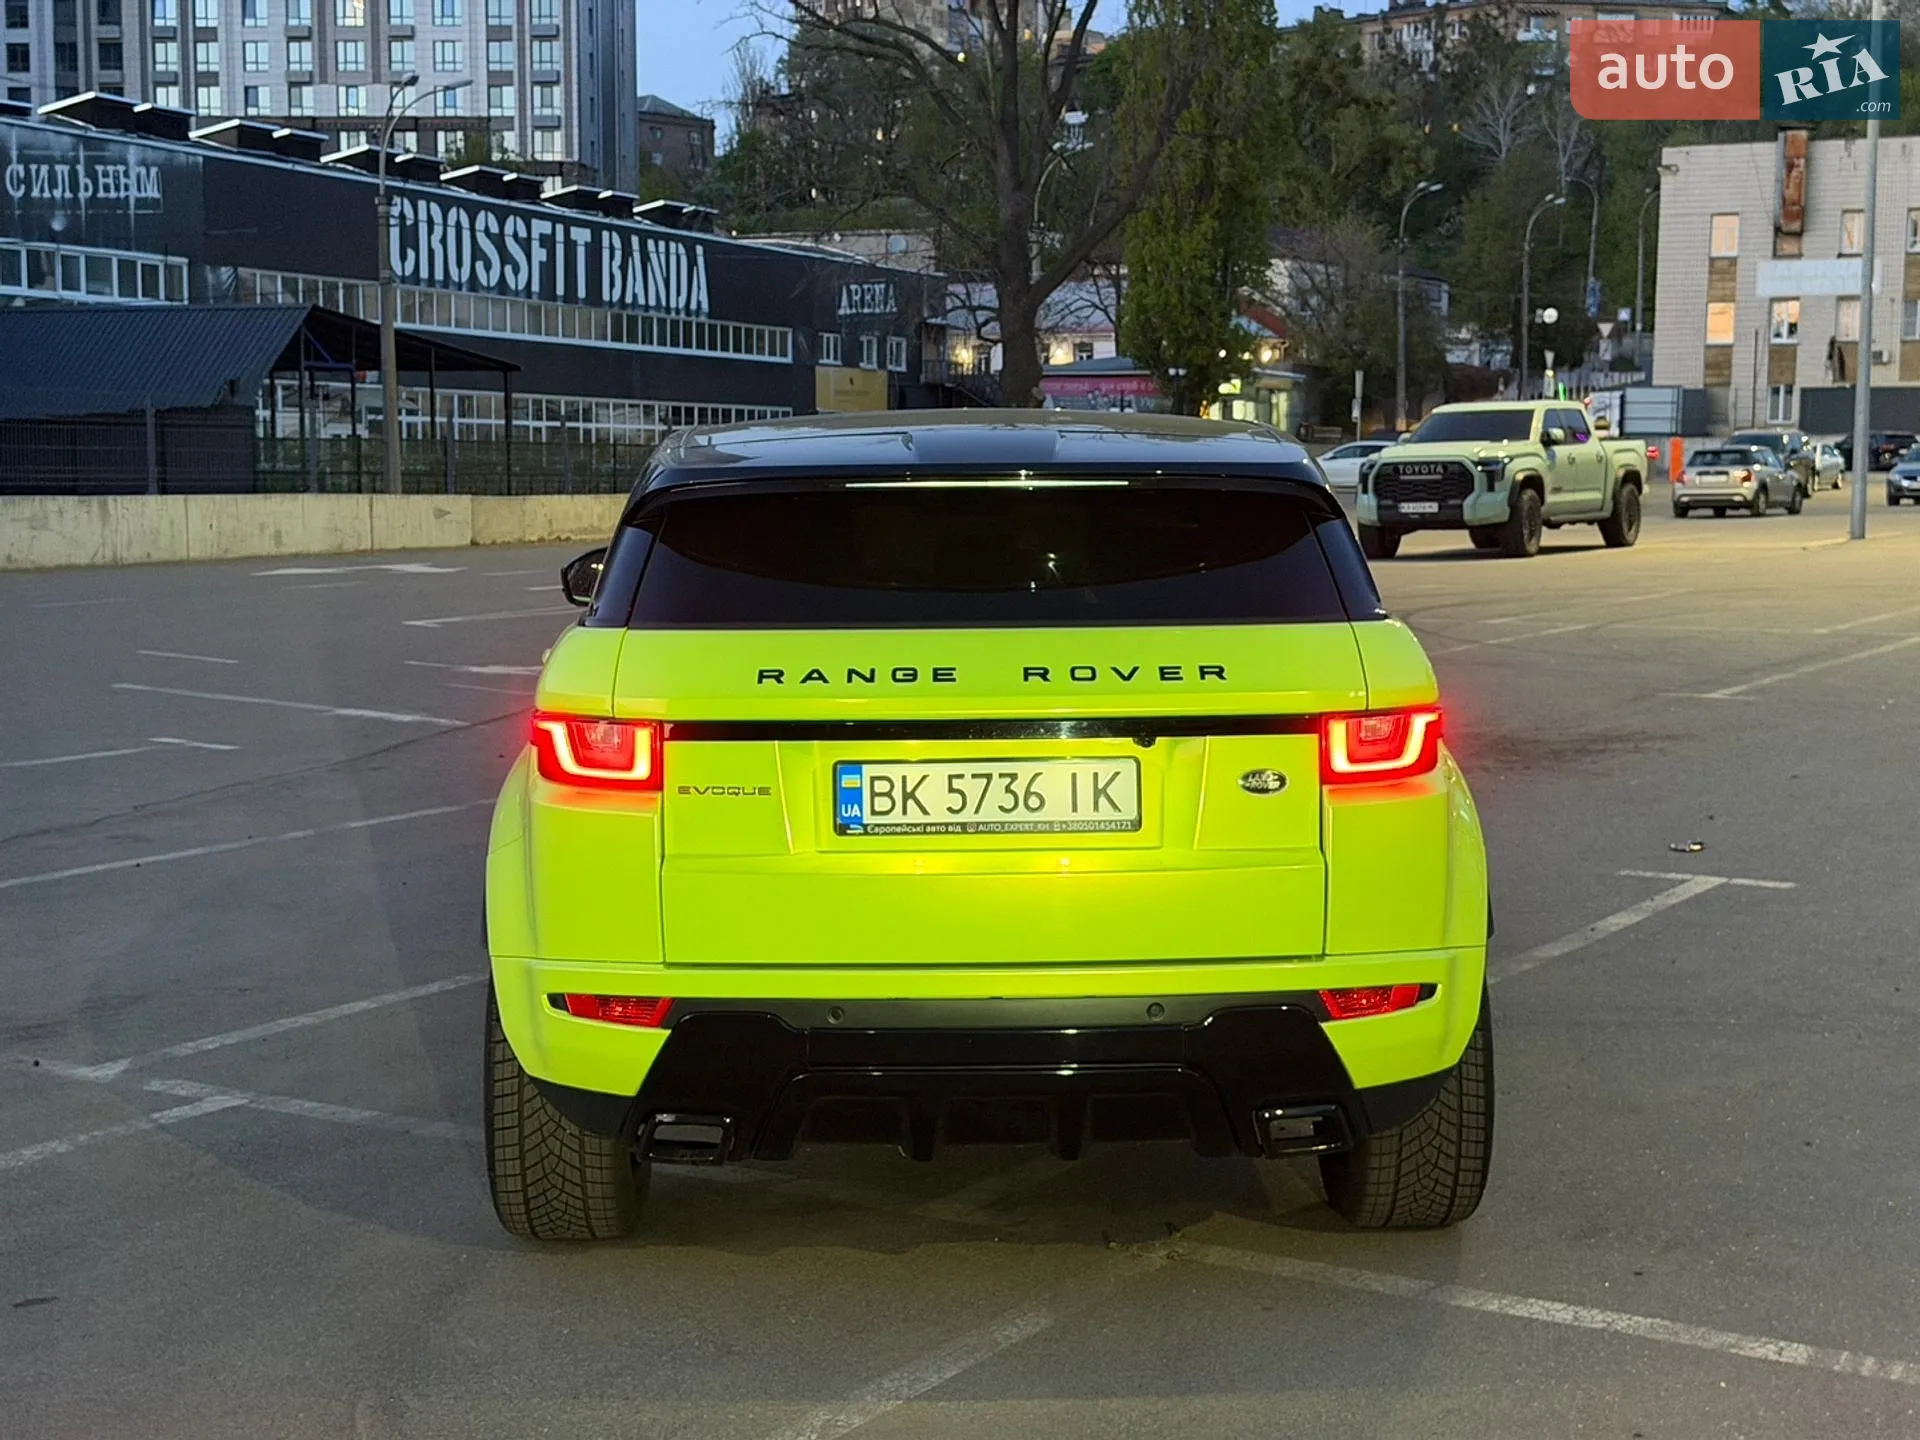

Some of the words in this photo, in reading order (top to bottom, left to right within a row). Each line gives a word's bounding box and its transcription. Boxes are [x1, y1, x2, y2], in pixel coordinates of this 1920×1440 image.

[5, 163, 161, 199] СИЛЬНЫМ
[388, 195, 592, 299] CROSSFIT
[601, 229, 710, 314] BANDA
[837, 283, 898, 316] ARENA
[1399, 464, 1444, 475] TOYOTA
[756, 666, 957, 685] RANGE
[1022, 664, 1228, 683] ROVER
[677, 785, 772, 797] EVOQUE
[868, 774, 932, 818] BK
[945, 772, 1047, 816] 5736
[1070, 770, 1123, 814] IK
[841, 803, 861, 818] UA
[925, 823, 946, 833] авто
